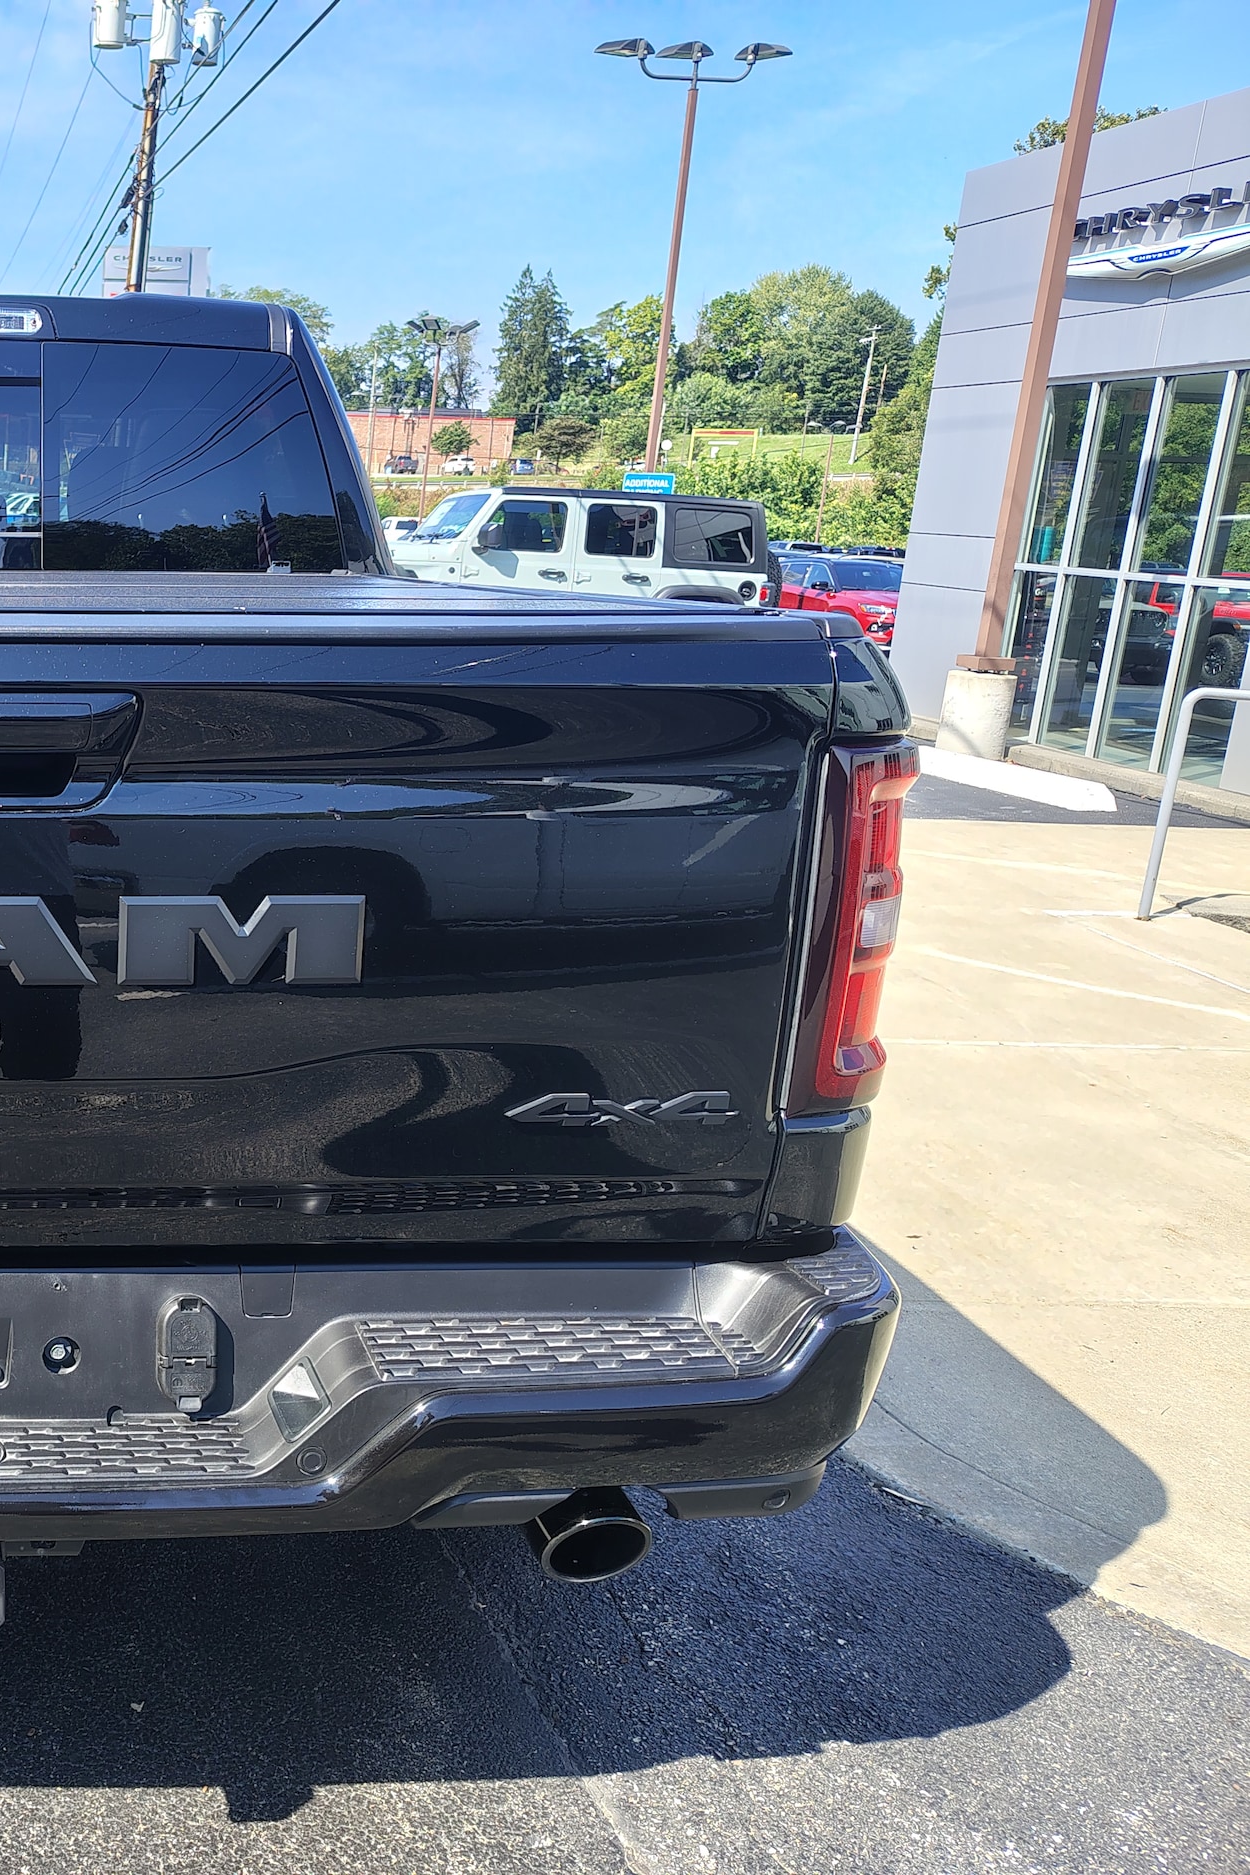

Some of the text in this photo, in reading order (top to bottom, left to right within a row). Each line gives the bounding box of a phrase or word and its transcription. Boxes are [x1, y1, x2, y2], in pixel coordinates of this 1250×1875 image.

[113, 255, 183, 263] CHSLER
[1133, 248, 1182, 263] CHRYSLER
[625, 479, 670, 488] ADDITIONAL
